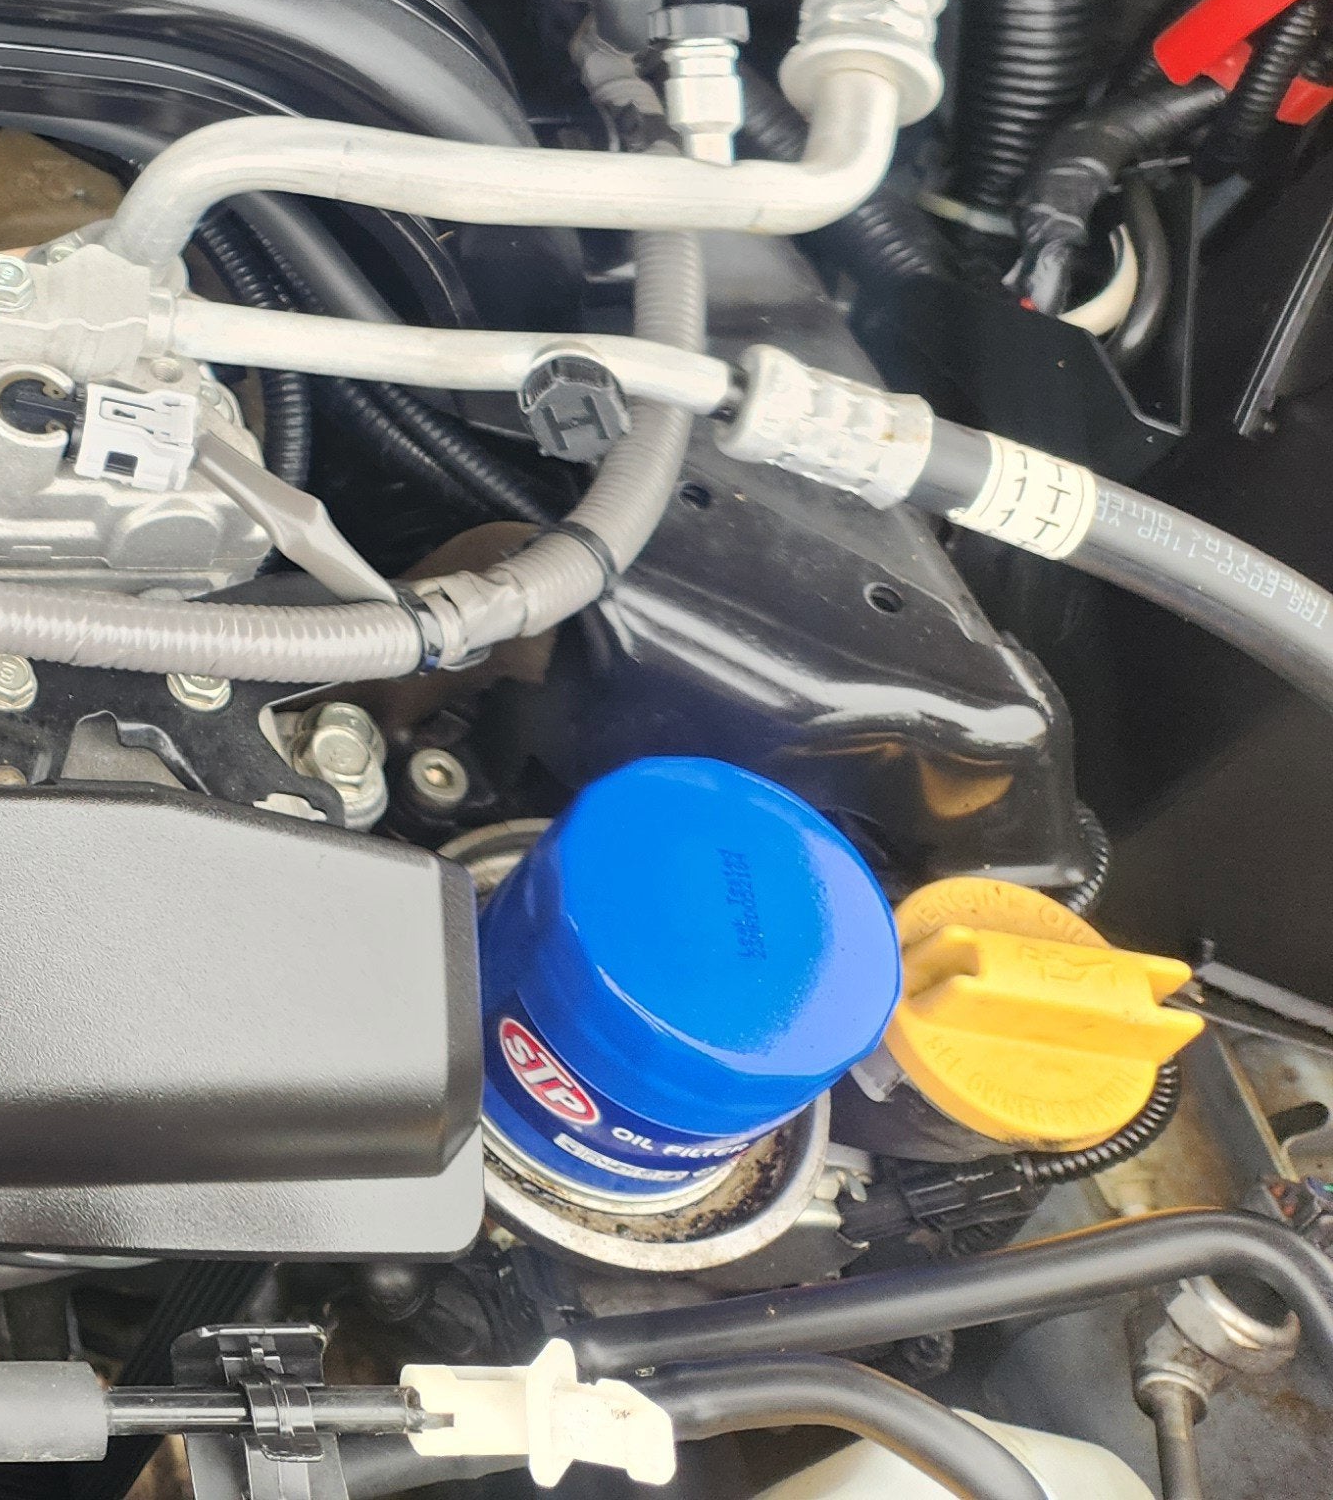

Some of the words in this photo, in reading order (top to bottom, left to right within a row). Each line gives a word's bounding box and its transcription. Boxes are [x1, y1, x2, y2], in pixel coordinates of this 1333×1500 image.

[539, 394, 612, 451] H
[1046, 484, 1072, 515] T
[1034, 516, 1061, 540] T
[505, 1034, 588, 1114] STP
[611, 1126, 654, 1151] OIL
